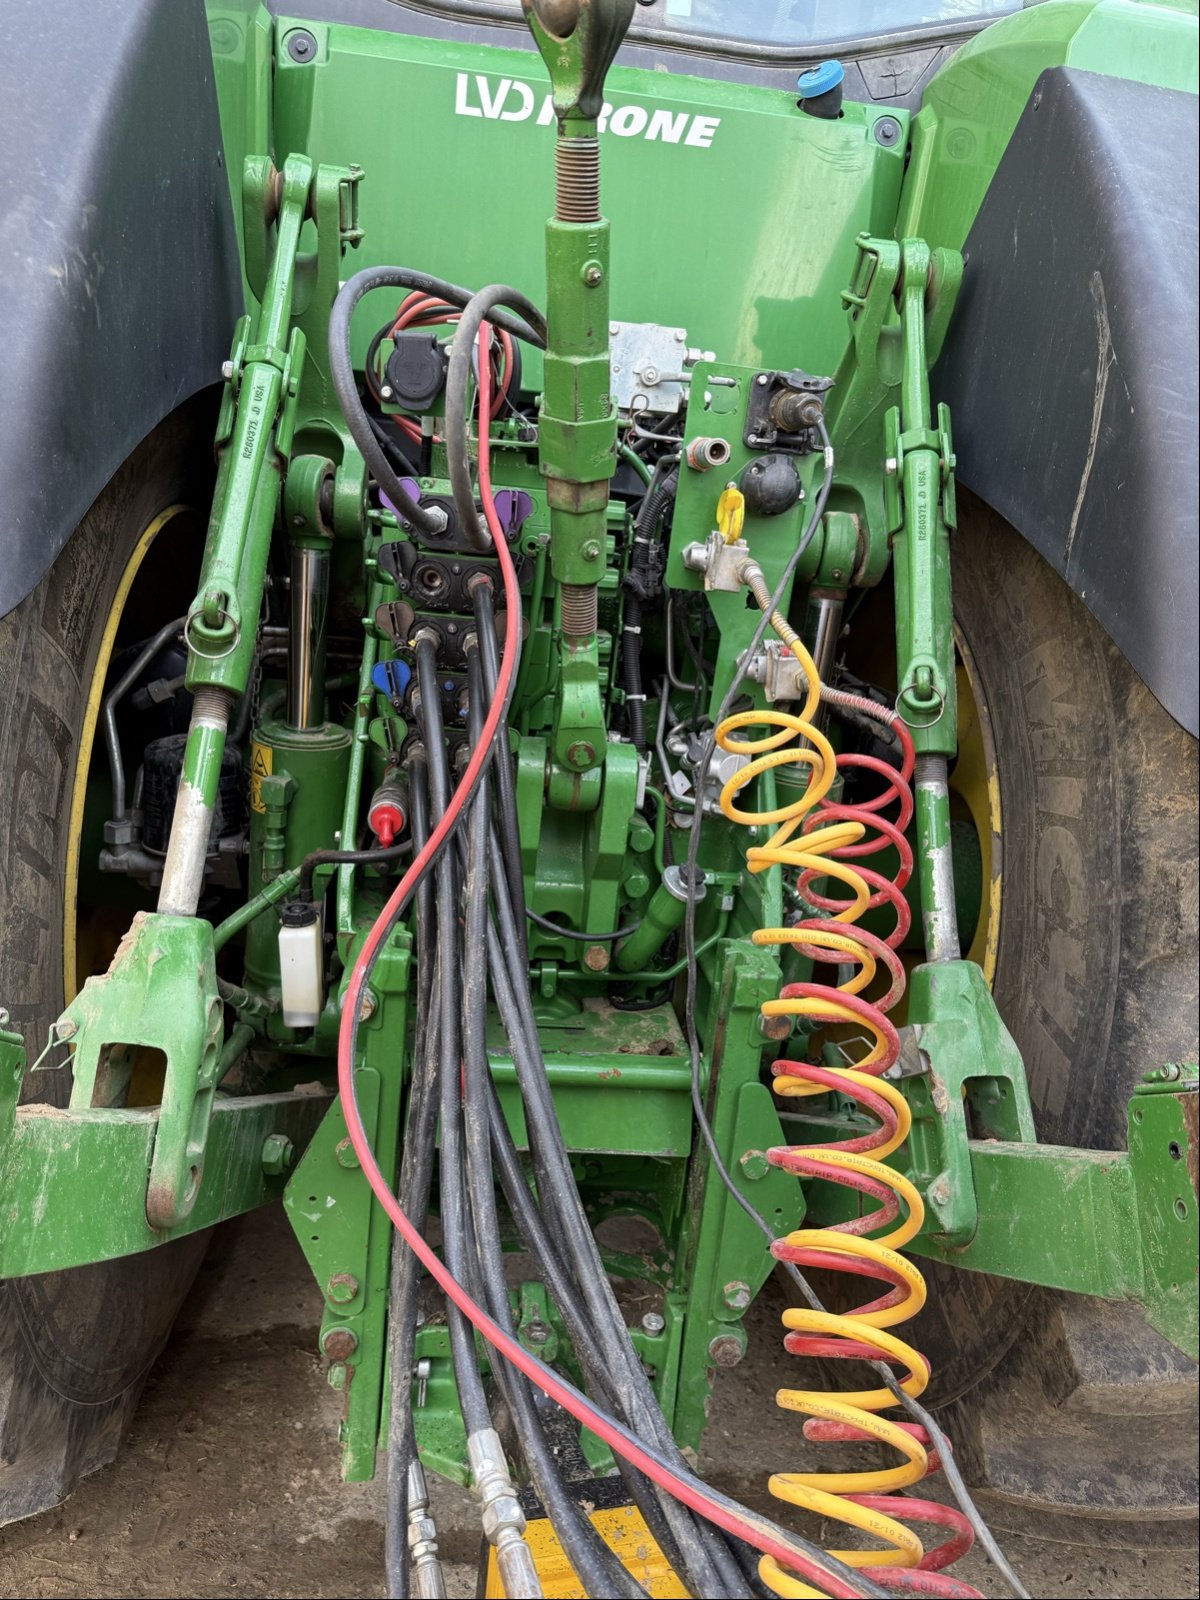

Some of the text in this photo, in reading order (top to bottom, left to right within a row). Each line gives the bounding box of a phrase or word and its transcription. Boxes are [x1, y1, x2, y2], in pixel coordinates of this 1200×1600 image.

[455, 73, 535, 122] LVD
[254, 385, 265, 402] USA
[918, 470, 927, 487] USA
